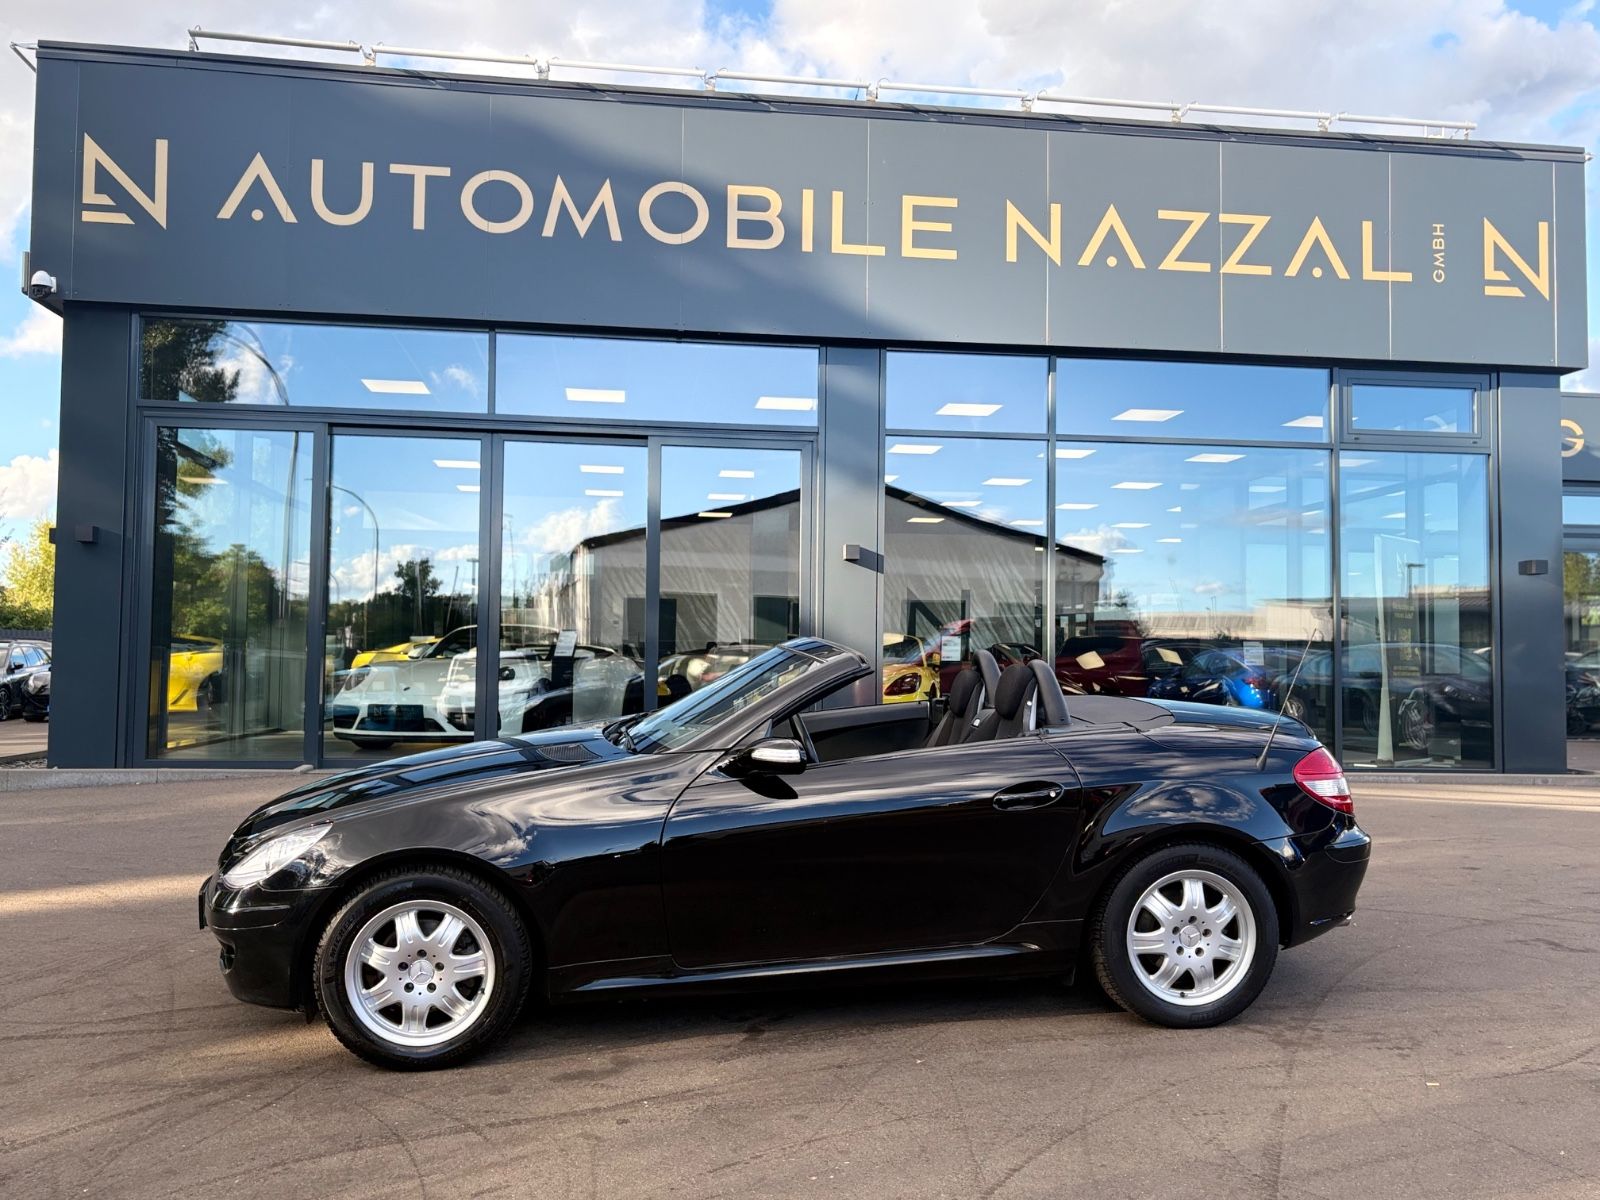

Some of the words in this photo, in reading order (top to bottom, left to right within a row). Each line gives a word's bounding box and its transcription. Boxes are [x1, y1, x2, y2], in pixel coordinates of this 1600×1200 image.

[217, 152, 961, 262] AUTOMOBILE
[1004, 199, 1413, 284] NAZZAL
[1431, 223, 1446, 283] GMBH
